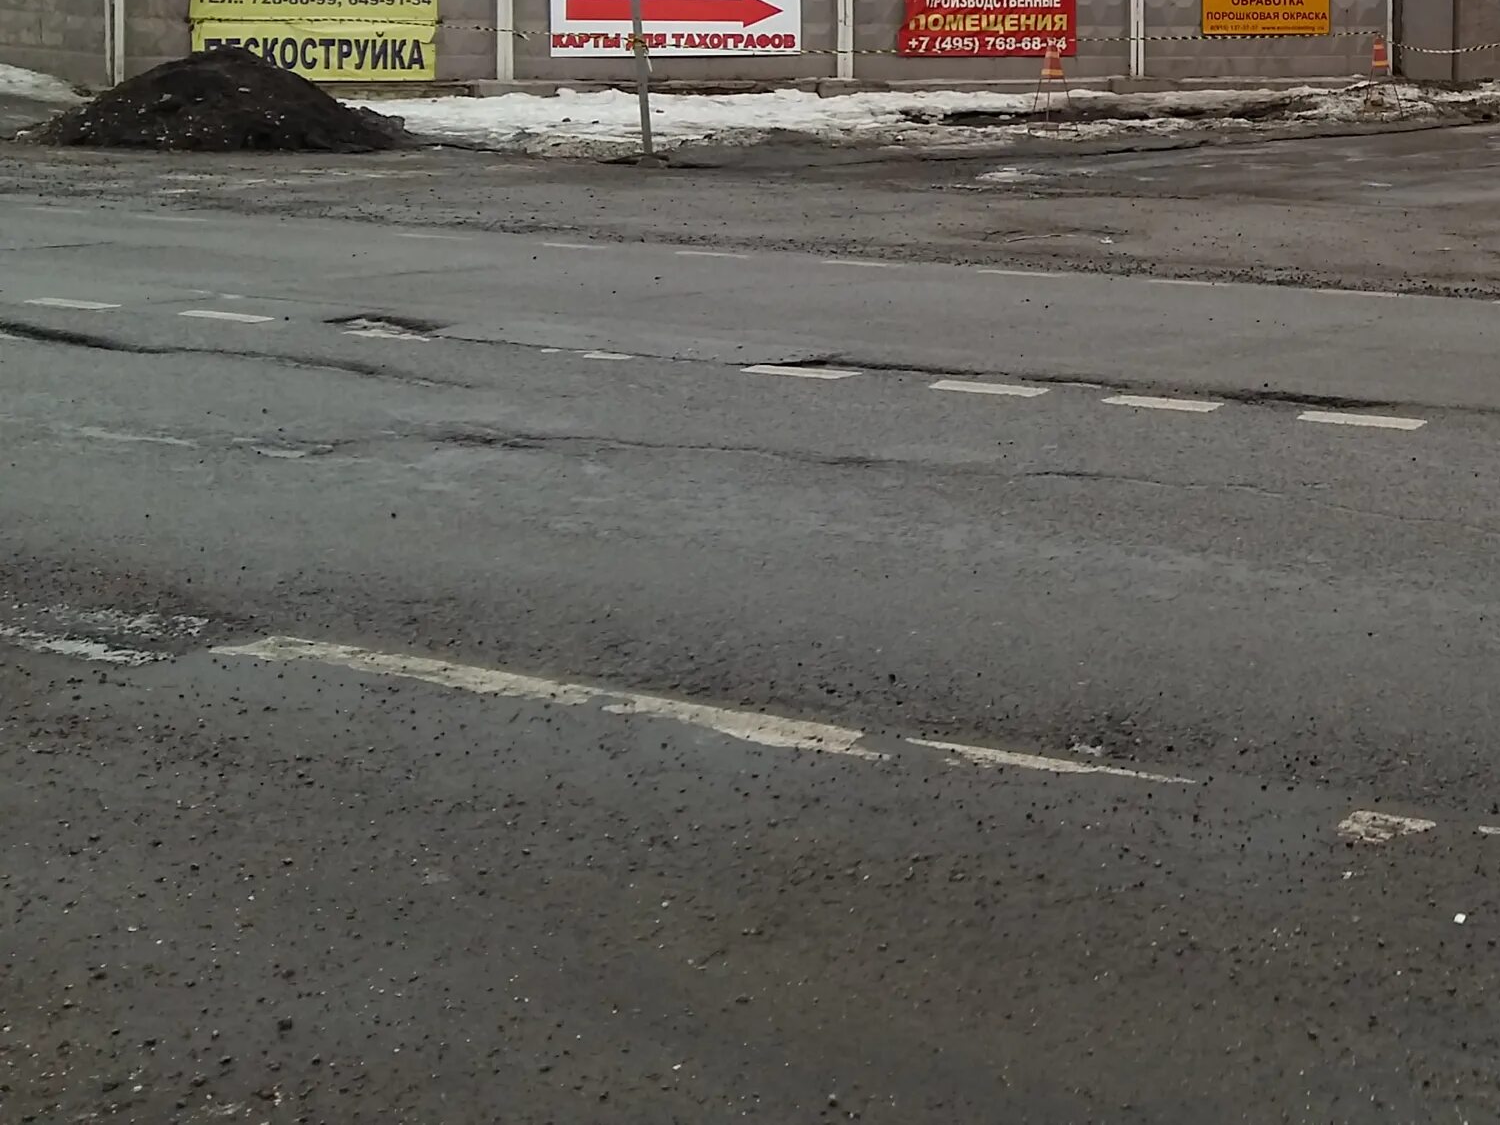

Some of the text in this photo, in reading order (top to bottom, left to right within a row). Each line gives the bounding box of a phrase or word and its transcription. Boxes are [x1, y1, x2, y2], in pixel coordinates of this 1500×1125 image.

[1206, 11, 1327, 20] ПОРОШКОВАЯ ОКРАСКА
[909, 14, 1068, 34] ПОМЕЩЕНИЯ
[552, 33, 621, 48] КАРТЫ
[671, 33, 796, 49] ТАХОГРАФОВ
[908, 37, 930, 51] +7
[935, 37, 979, 53] (495)
